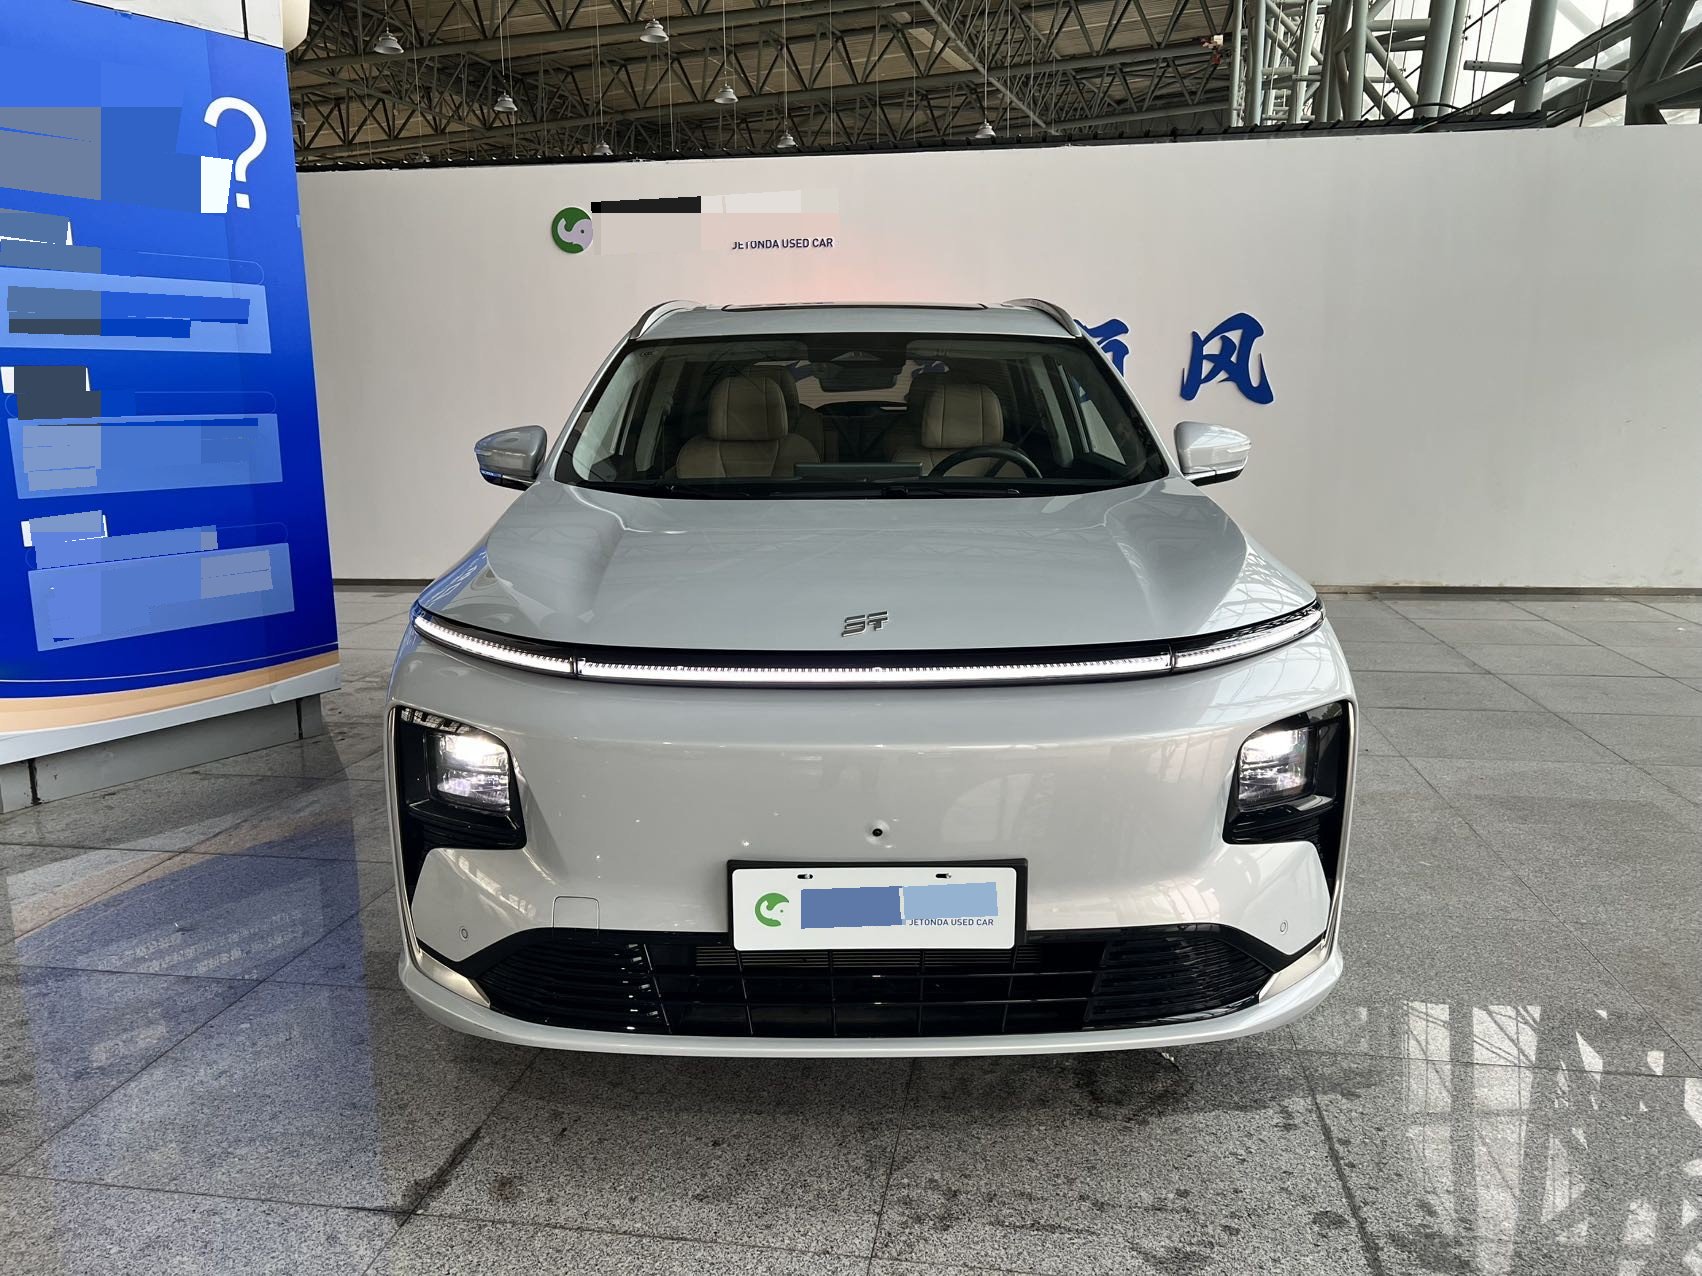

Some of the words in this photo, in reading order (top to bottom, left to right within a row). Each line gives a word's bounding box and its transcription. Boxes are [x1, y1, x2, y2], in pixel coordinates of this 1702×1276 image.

[732, 239, 780, 250] JETONDA
[781, 238, 810, 249] USED
[812, 237, 834, 248] CAR
[909, 918, 949, 926] JETONDA
[950, 918, 974, 926] USED
[976, 918, 994, 926] CAR
